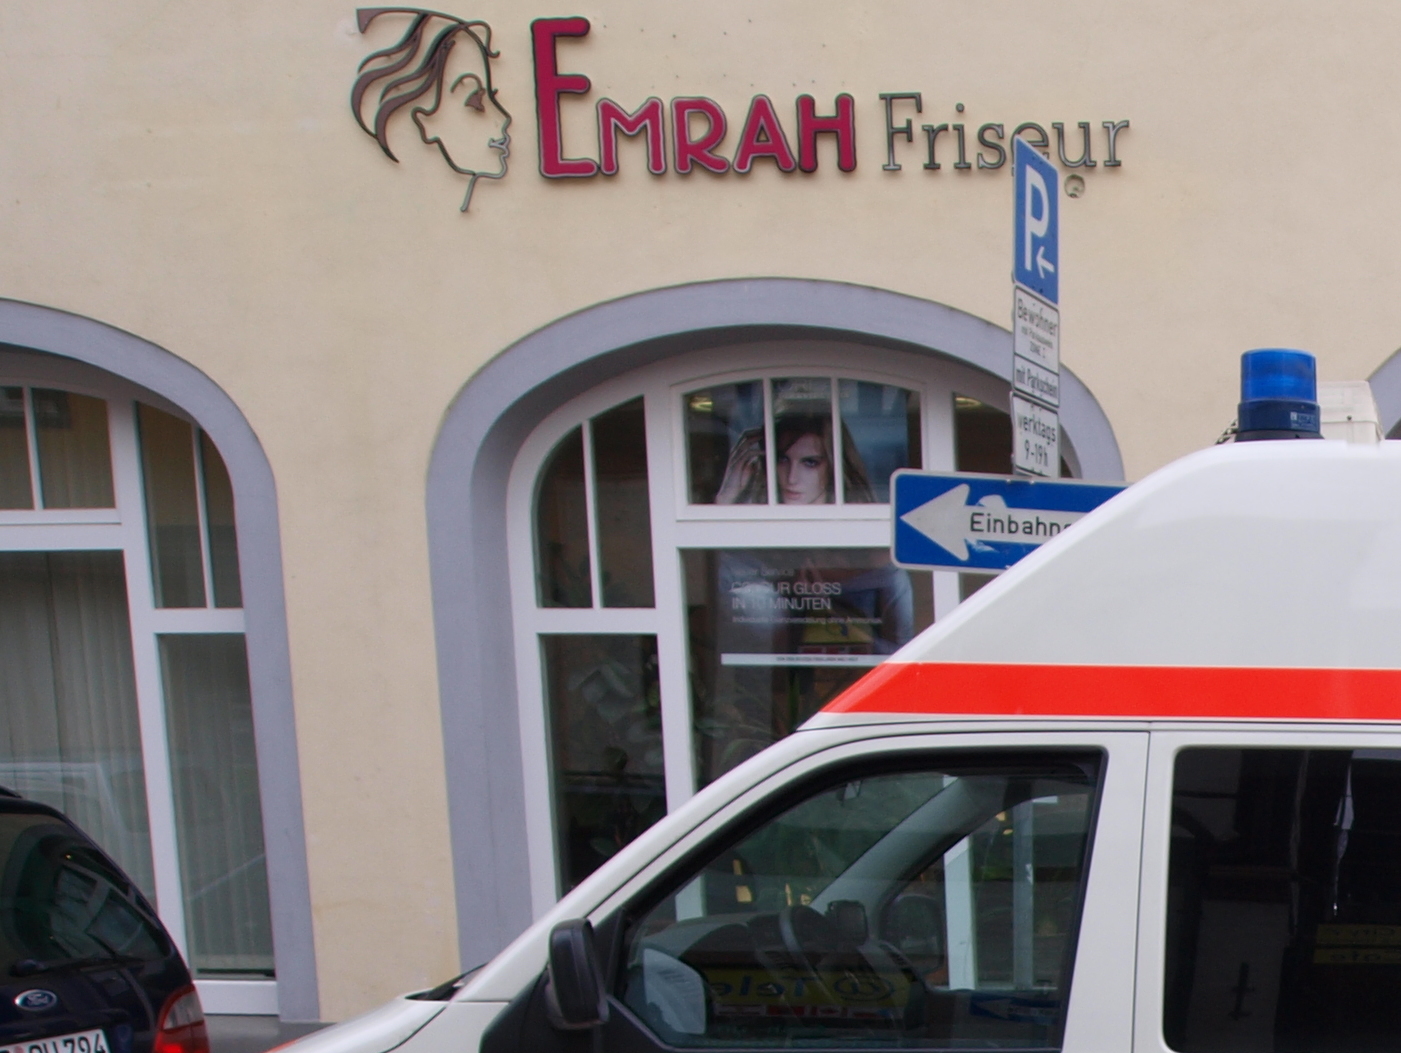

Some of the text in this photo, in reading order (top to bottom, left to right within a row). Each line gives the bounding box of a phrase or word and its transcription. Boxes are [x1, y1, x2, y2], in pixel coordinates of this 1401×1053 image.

[879, 91, 1130, 171] Friseur
[1024, 163, 1050, 271] P
[769, 597, 832, 610] MINUTEN
[793, 582, 842, 595] GLOSS
